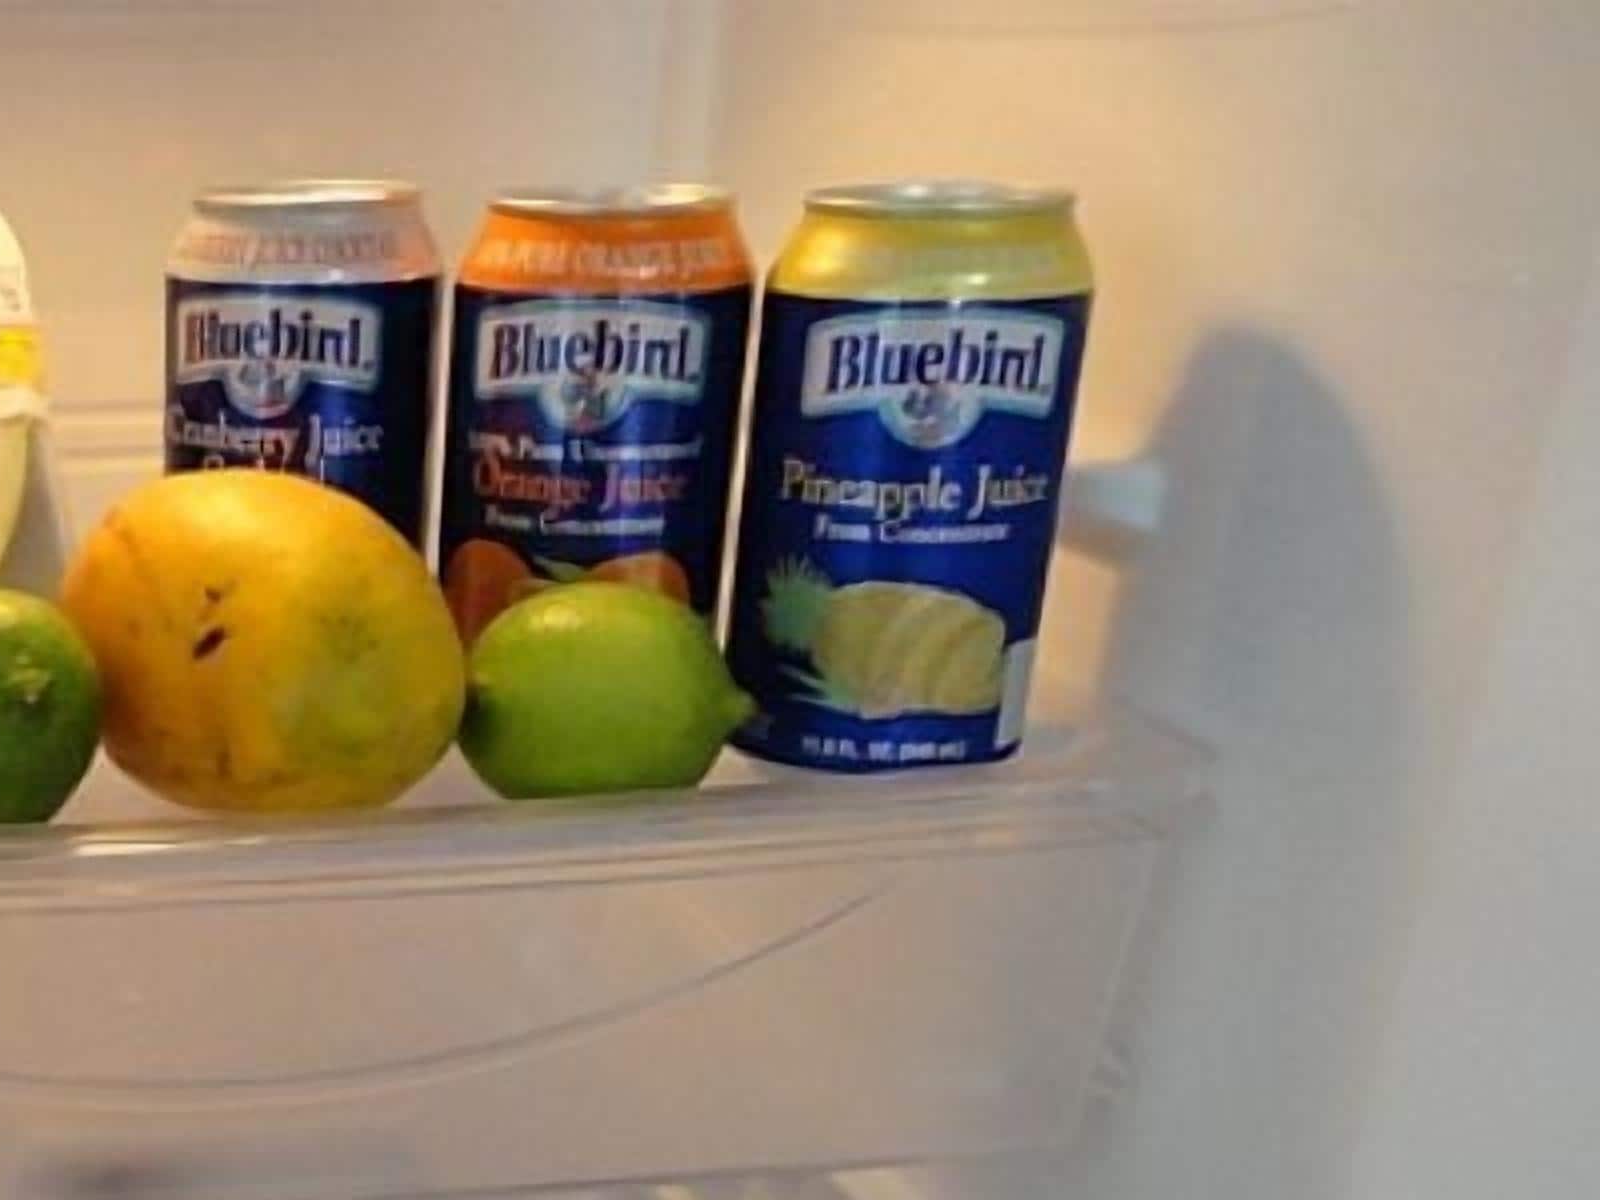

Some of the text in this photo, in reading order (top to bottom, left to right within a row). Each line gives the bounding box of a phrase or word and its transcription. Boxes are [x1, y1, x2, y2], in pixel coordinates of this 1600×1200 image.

[183, 306, 362, 370] Bluebird
[490, 318, 692, 381] Bluebird
[825, 328, 1046, 394] Bluebird
[305, 414, 384, 469] Juice
[473, 452, 690, 520] Orange Juice
[782, 458, 1050, 522] Pineapple Juice
